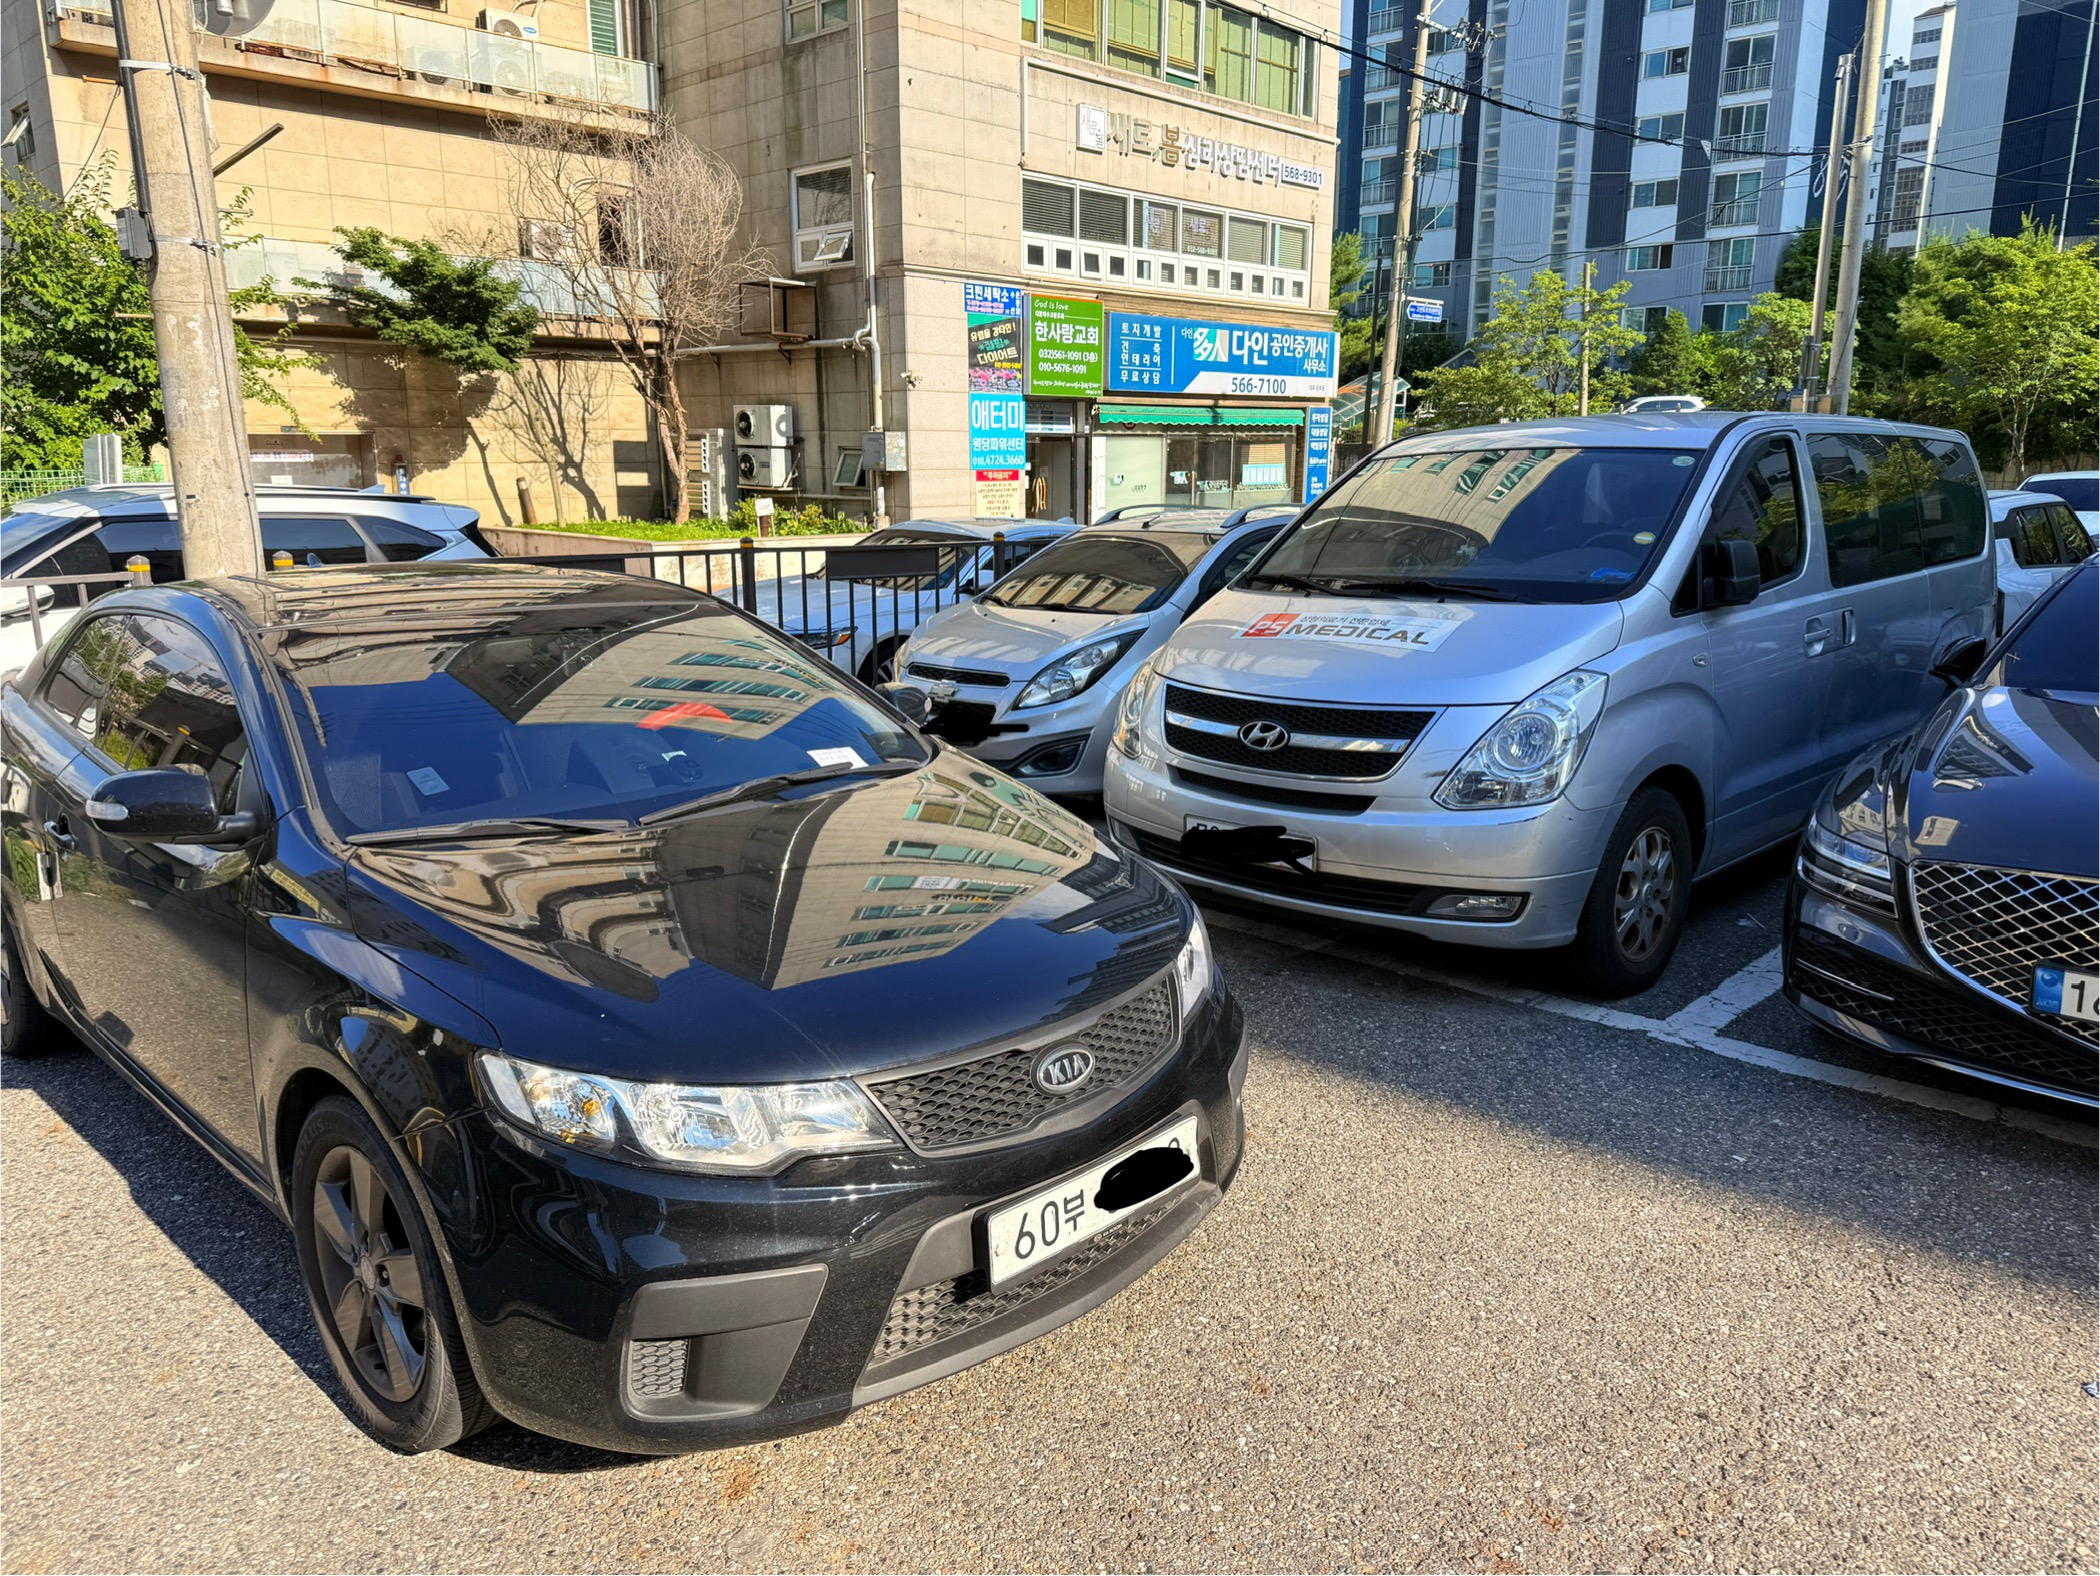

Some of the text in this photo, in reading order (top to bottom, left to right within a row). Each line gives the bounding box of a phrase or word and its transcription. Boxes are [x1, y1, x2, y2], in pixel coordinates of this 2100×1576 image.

[1284, 165, 1322, 185] 568-9301
[1034, 299, 1069, 311] God is love
[1034, 320, 1099, 346] 한사랑교회
[1121, 322, 1161, 338] 토지개발
[976, 346, 1019, 365] 다이어트
[1038, 349, 1082, 361] 032)561-1091
[1232, 330, 1328, 366] 다인 공인중개사
[1038, 362, 1087, 374] 010-5676-1091
[1121, 353, 1161, 367] 인테리어
[1303, 358, 1327, 374] 사무소
[1121, 370, 1160, 384] 무료상담
[1231, 377, 1286, 395] 566-7100
[971, 400, 1024, 431] 애터미
[973, 437, 1024, 452] 원당파워센터
[972, 454, 1024, 466] 010.4724.3660
[1285, 623, 1429, 645] MEDICAL
[1047, 1053, 1086, 1085] KIA
[1015, 1188, 1085, 1260] 60부
